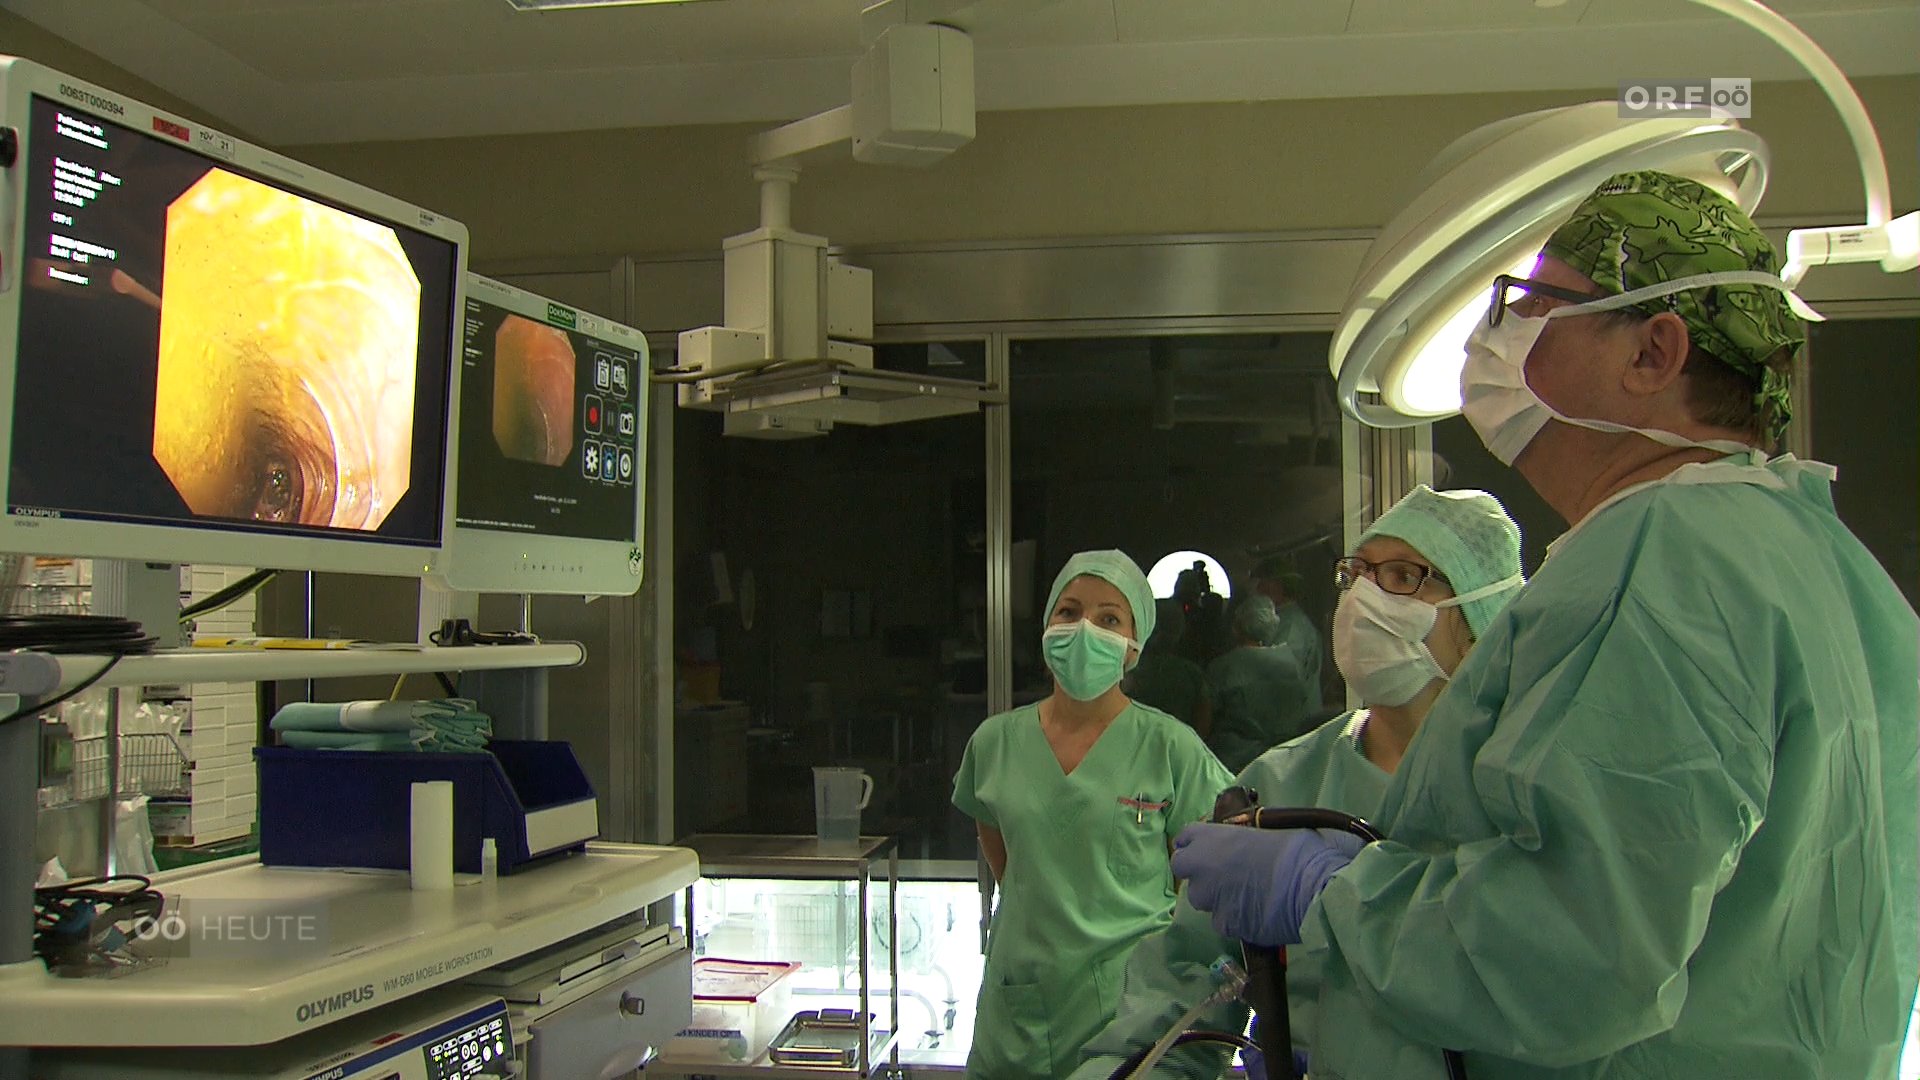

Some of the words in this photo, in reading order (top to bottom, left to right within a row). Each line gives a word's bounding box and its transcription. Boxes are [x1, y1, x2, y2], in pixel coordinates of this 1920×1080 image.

[15, 507, 61, 518] OLYMPUS
[296, 984, 374, 1023] OLYMPUS
[416, 962, 444, 981] MOBILE
[445, 947, 493, 972] WORKSTATION
